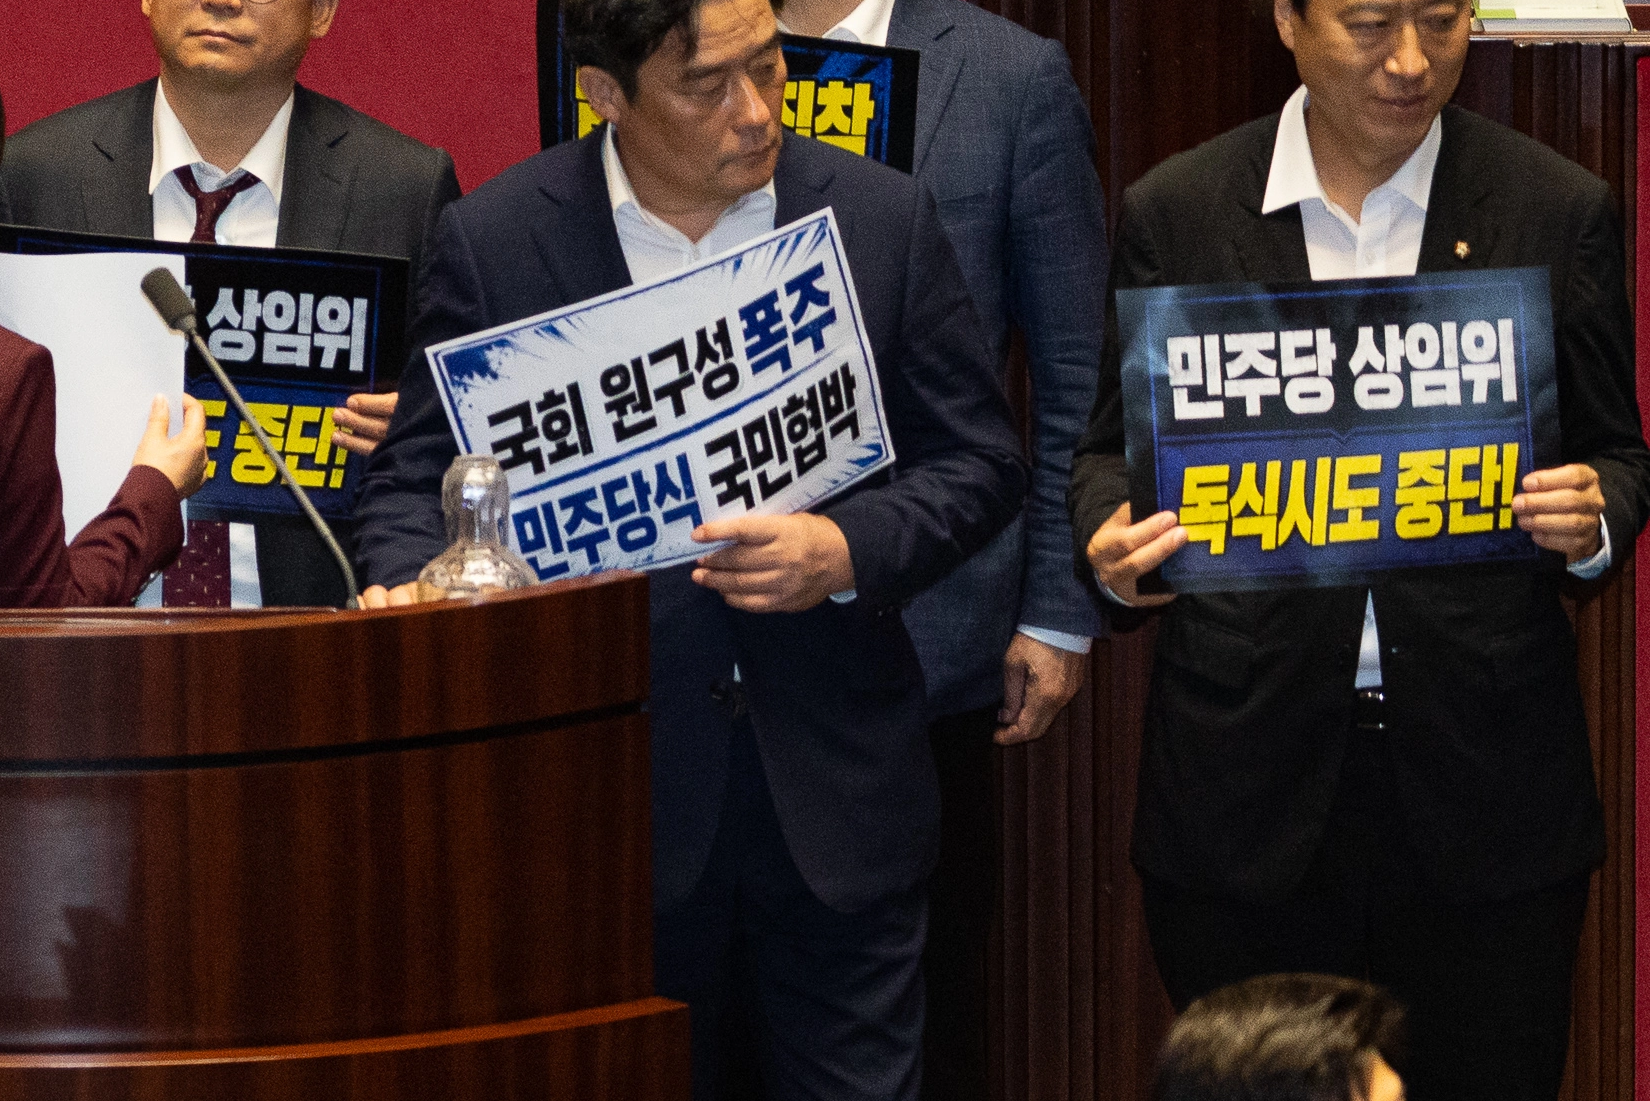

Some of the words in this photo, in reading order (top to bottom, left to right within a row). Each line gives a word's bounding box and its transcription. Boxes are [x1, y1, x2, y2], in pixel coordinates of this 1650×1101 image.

[206, 287, 368, 372] 상임위
[488, 382, 594, 475] 국회
[599, 317, 740, 443] 원구성
[738, 262, 837, 376] 폭주
[1167, 327, 1336, 420] 민주당
[1349, 317, 1518, 411] 상임위
[511, 453, 704, 581] 민주당식
[705, 362, 861, 511] 국민협박
[1179, 453, 1382, 555] 독식시도
[1395, 442, 1520, 541] 중단!
